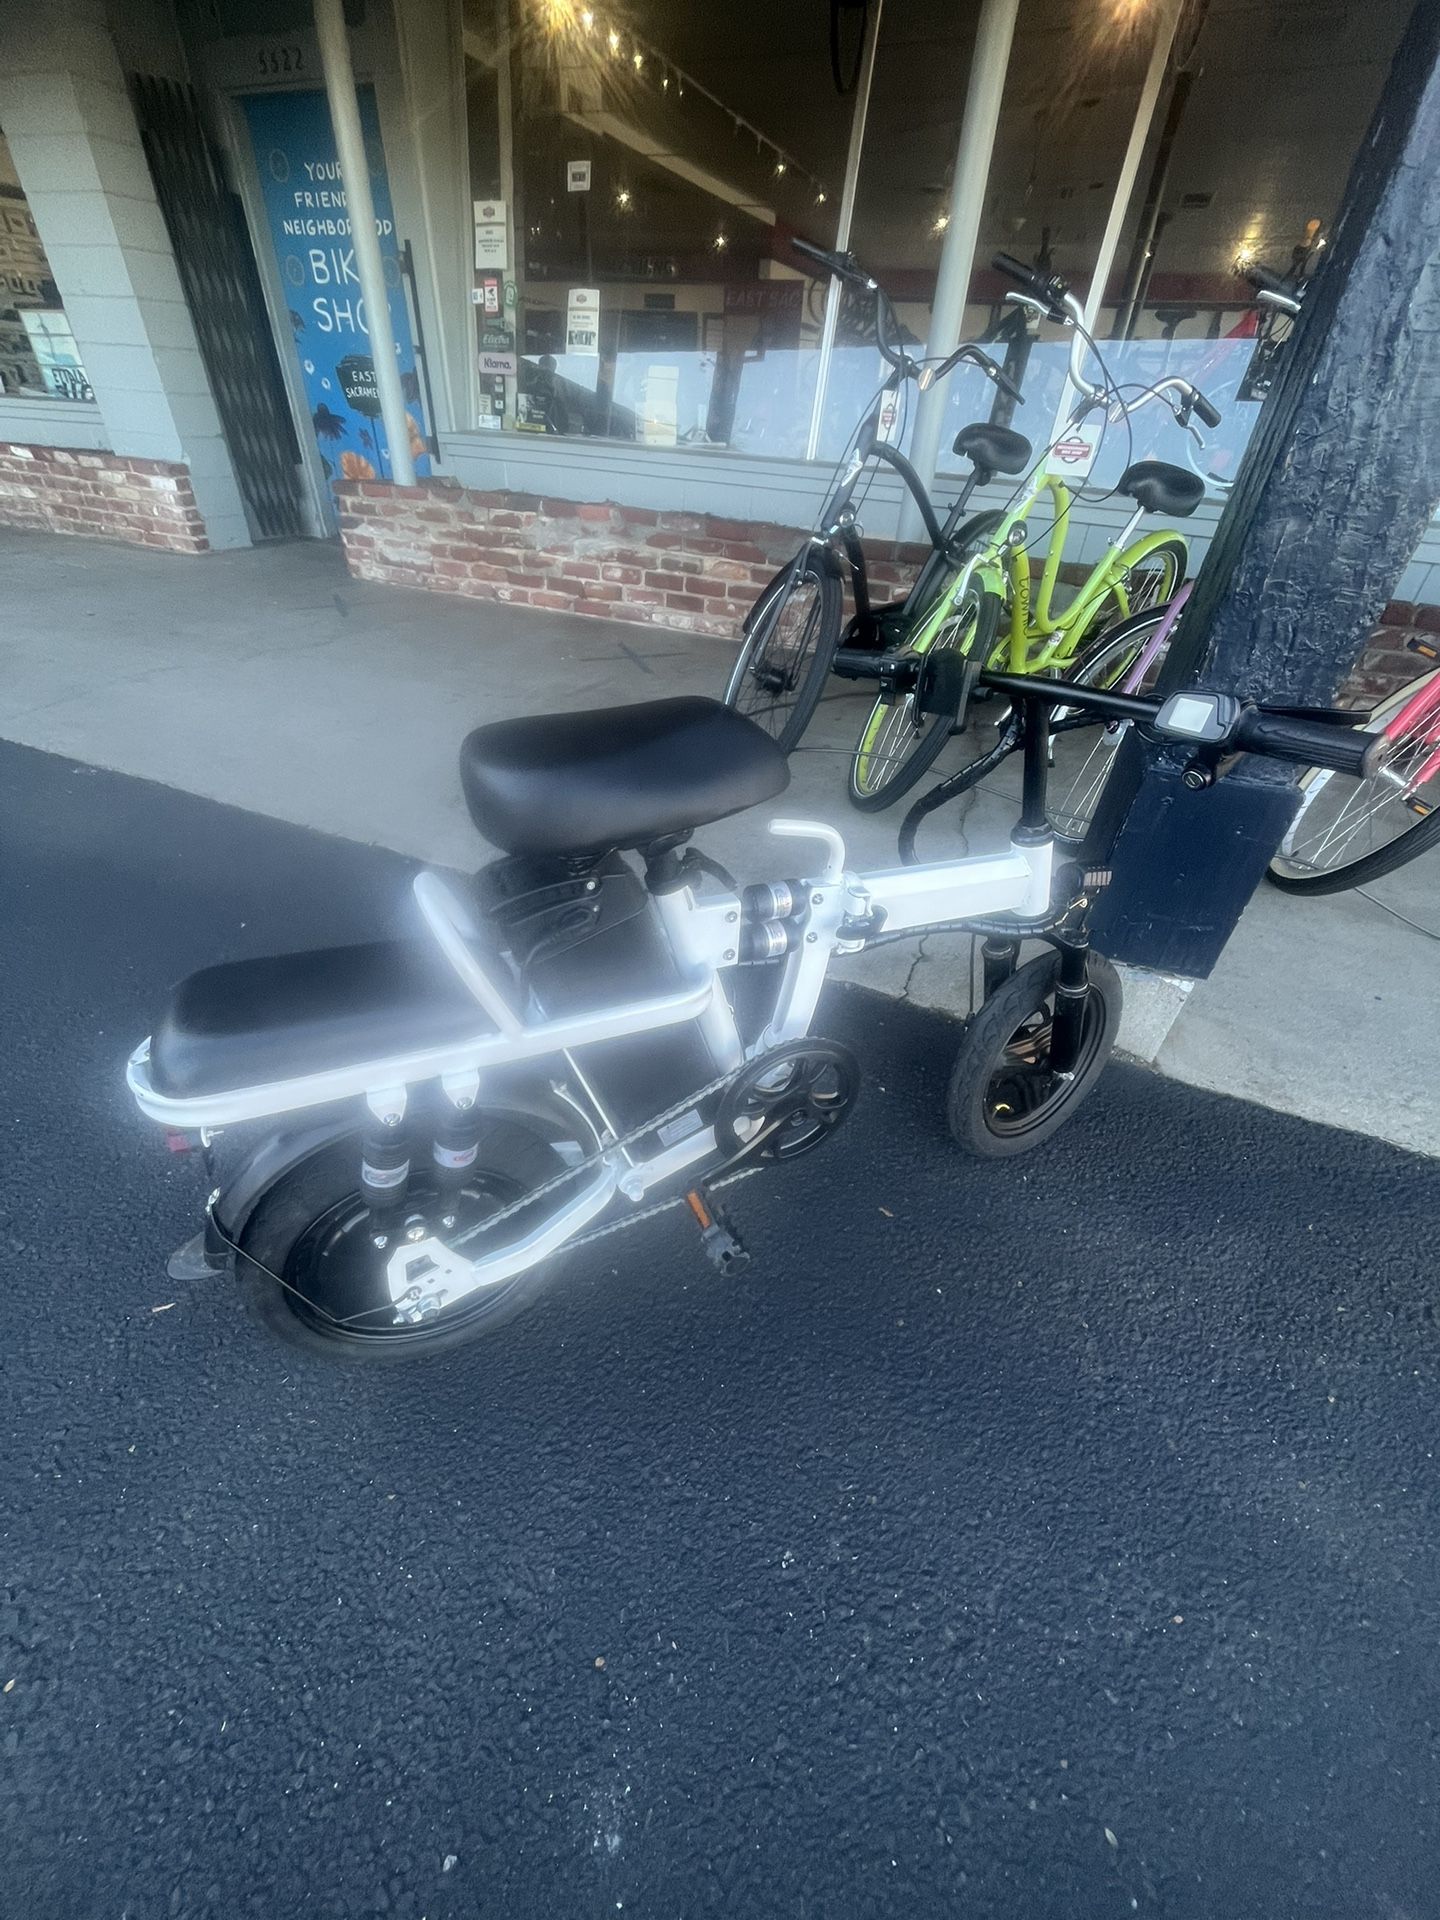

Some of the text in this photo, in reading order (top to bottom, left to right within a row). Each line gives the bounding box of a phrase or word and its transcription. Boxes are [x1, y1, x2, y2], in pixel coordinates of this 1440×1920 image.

[294, 191, 347, 208] FRIEN
[283, 218, 392, 236] NEIGHBORD
[309, 248, 361, 285] BIK
[352, 370, 376, 382] EAST
[345, 387, 378, 398] SACRAME
